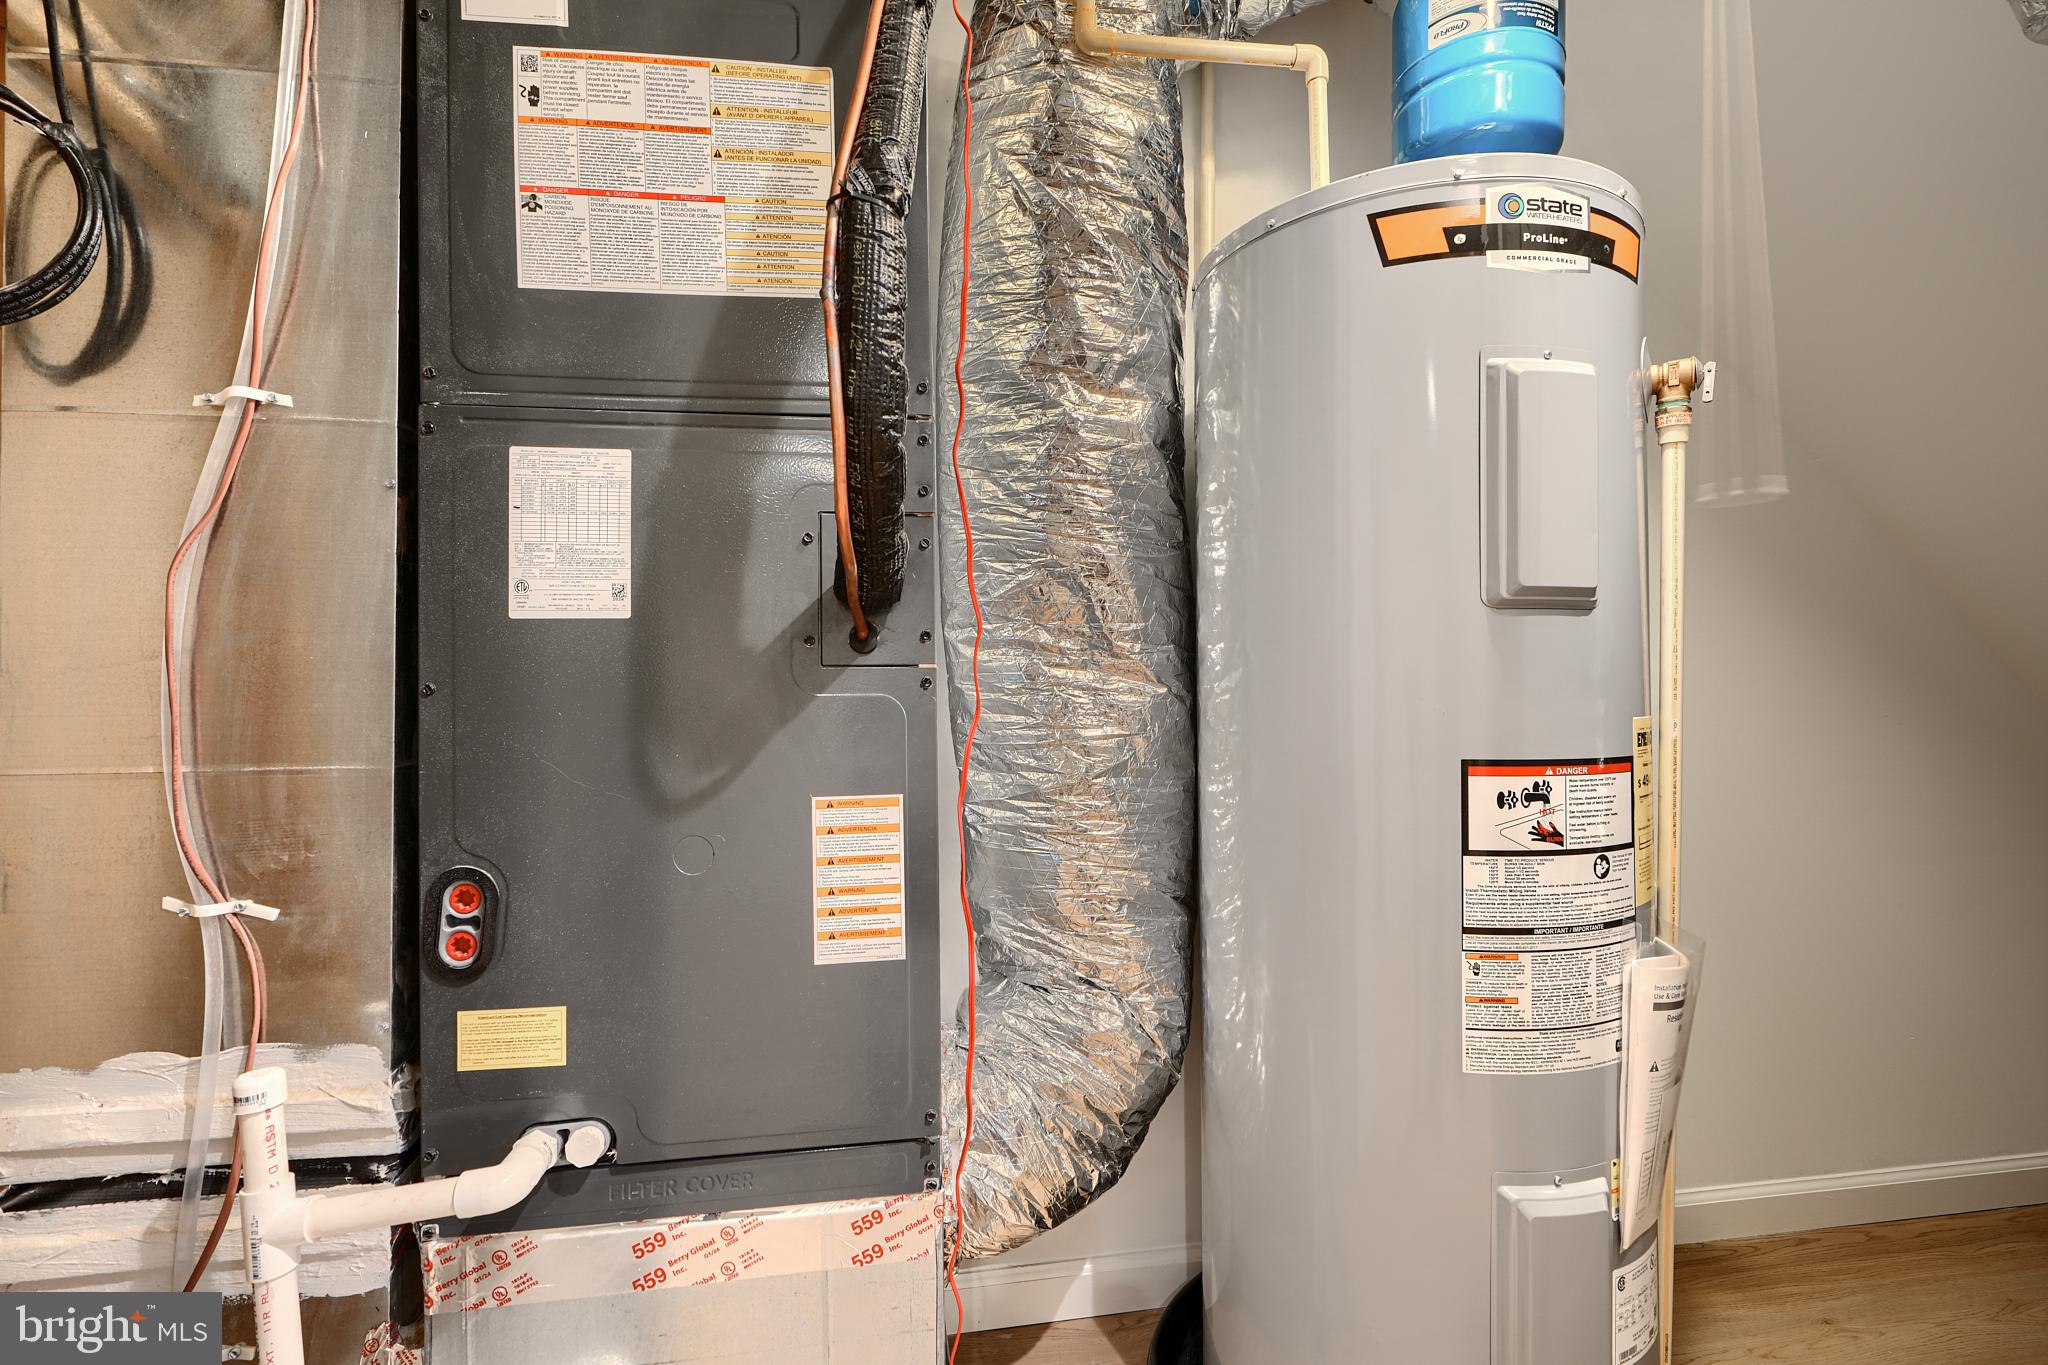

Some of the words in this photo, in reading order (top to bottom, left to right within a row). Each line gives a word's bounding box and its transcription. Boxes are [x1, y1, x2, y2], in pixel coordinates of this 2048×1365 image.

[593, 120, 635, 128] ADVERTENCIA
[658, 125, 707, 133] AVERTISSEMENT
[1526, 198, 1582, 217] state
[1553, 214, 1582, 225] HEATERS
[839, 930, 886, 938] AVERTISSEMENT
[1573, 924, 1604, 933] IMPORTANTE
[266, 1124, 276, 1159] ASTM
[269, 1164, 278, 1174] D
[608, 1179, 677, 1201] FILTER
[685, 1172, 754, 1194] COVER
[850, 1210, 884, 1236] 559
[884, 1194, 904, 1210] Berry
[888, 1208, 902, 1218] Inc.
[632, 1232, 666, 1260] 559
[668, 1215, 690, 1232] Berry
[672, 1232, 687, 1241] Inc.
[851, 1244, 884, 1267] 559
[884, 1229, 905, 1243] Berry
[905, 1214, 930, 1232] Global
[435, 1239, 460, 1256] Berry
[889, 1243, 903, 1252] Inc.
[440, 1255, 456, 1266] Inc.
[632, 1267, 667, 1292] 559
[668, 1252, 690, 1268] Berry
[690, 1238, 716, 1255] Global
[496, 1262, 512, 1272] LISTED
[672, 1266, 688, 1277] Inc.
[435, 1278, 459, 1293] Berry
[460, 1262, 487, 1280] Global
[440, 1291, 456, 1302] Inc.
[497, 1297, 512, 1307] LISTED
